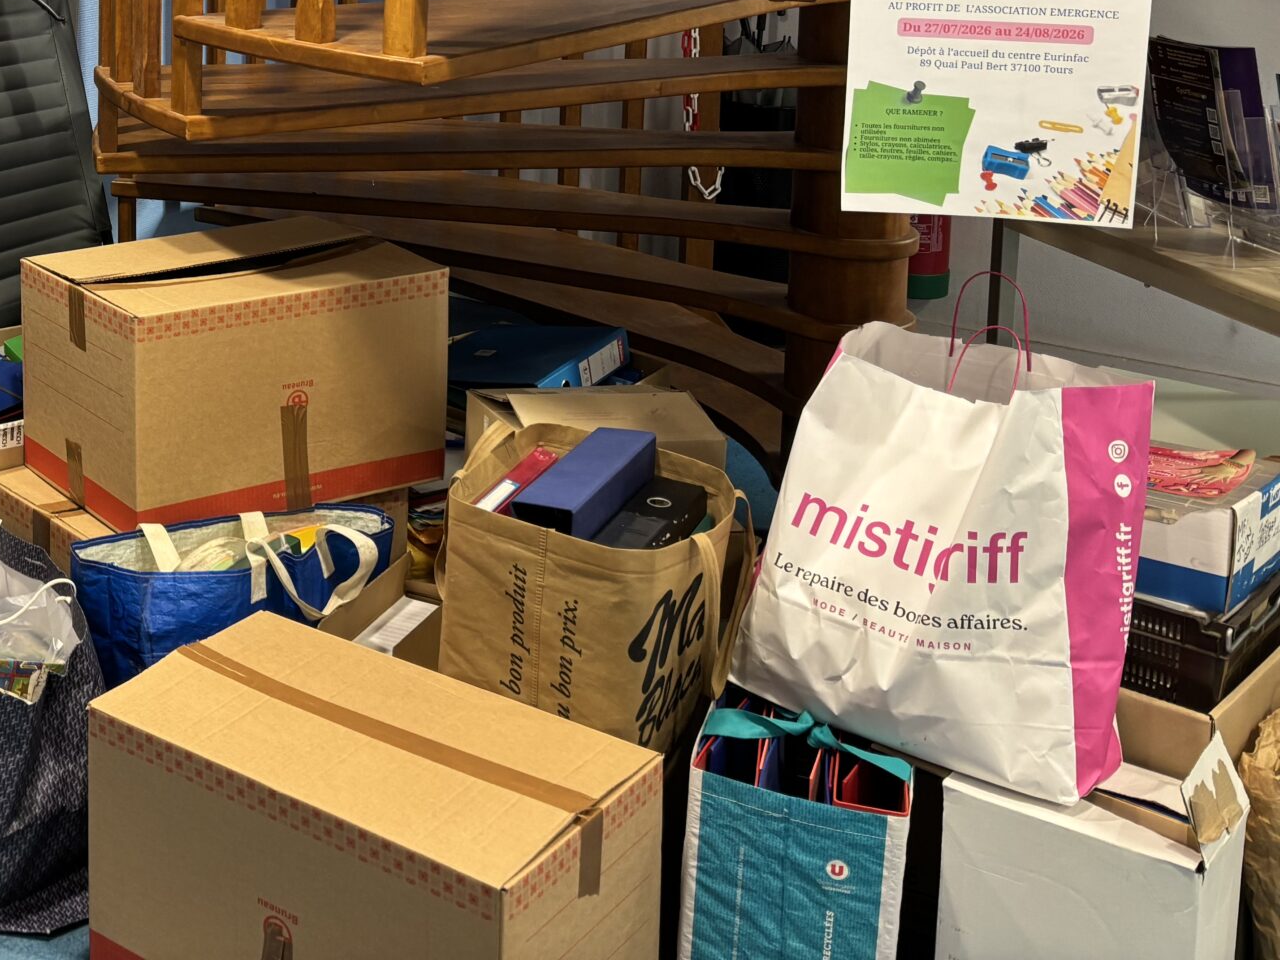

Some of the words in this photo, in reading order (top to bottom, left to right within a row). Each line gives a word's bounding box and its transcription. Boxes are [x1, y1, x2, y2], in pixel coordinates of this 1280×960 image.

[888, 1, 902, 10] AU
[905, 2, 943, 11] PROFIT
[946, 4, 960, 12] DE
[966, 4, 1047, 16] L'ASSOCIATION
[1050, 8, 1120, 19] EMERGENCE
[903, 22, 921, 33] Du
[924, 23, 992, 36] 27/07/2026
[995, 27, 1012, 36] au
[1015, 27, 1085, 40] 24/08/2026
[907, 45, 936, 57] Dépôt
[938, 47, 945, 56] à
[947, 48, 989, 58] l'accueil
[991, 50, 1005, 59] du
[1007, 51, 1041, 61] centre
[1043, 52, 1090, 63] Eurinfac
[919, 59, 932, 68] 89
[934, 60, 958, 69] Quai
[961, 61, 983, 70] Paul
[986, 62, 1008, 71] Bert
[1010, 63, 1041, 73] 37100
[1043, 65, 1074, 75] Tours
[885, 108, 900, 116] QUE
[282, 379, 315, 390] Bruneau
[773, 552, 794, 573] Le
[795, 566, 854, 597] repaire
[857, 588, 889, 611] des
[893, 601, 942, 628] boes
[947, 614, 1028, 631] affaires.
[505, 563, 531, 656] produit
[556, 598, 583, 657] prix.
[628, 572, 705, 694] Ma
[916, 639, 972, 651] MAISON
[500, 653, 524, 695] bon
[550, 654, 575, 700] bon
[557, 701, 571, 720] u
[830, 864, 844, 876] U
[257, 896, 299, 926] Bruneau
